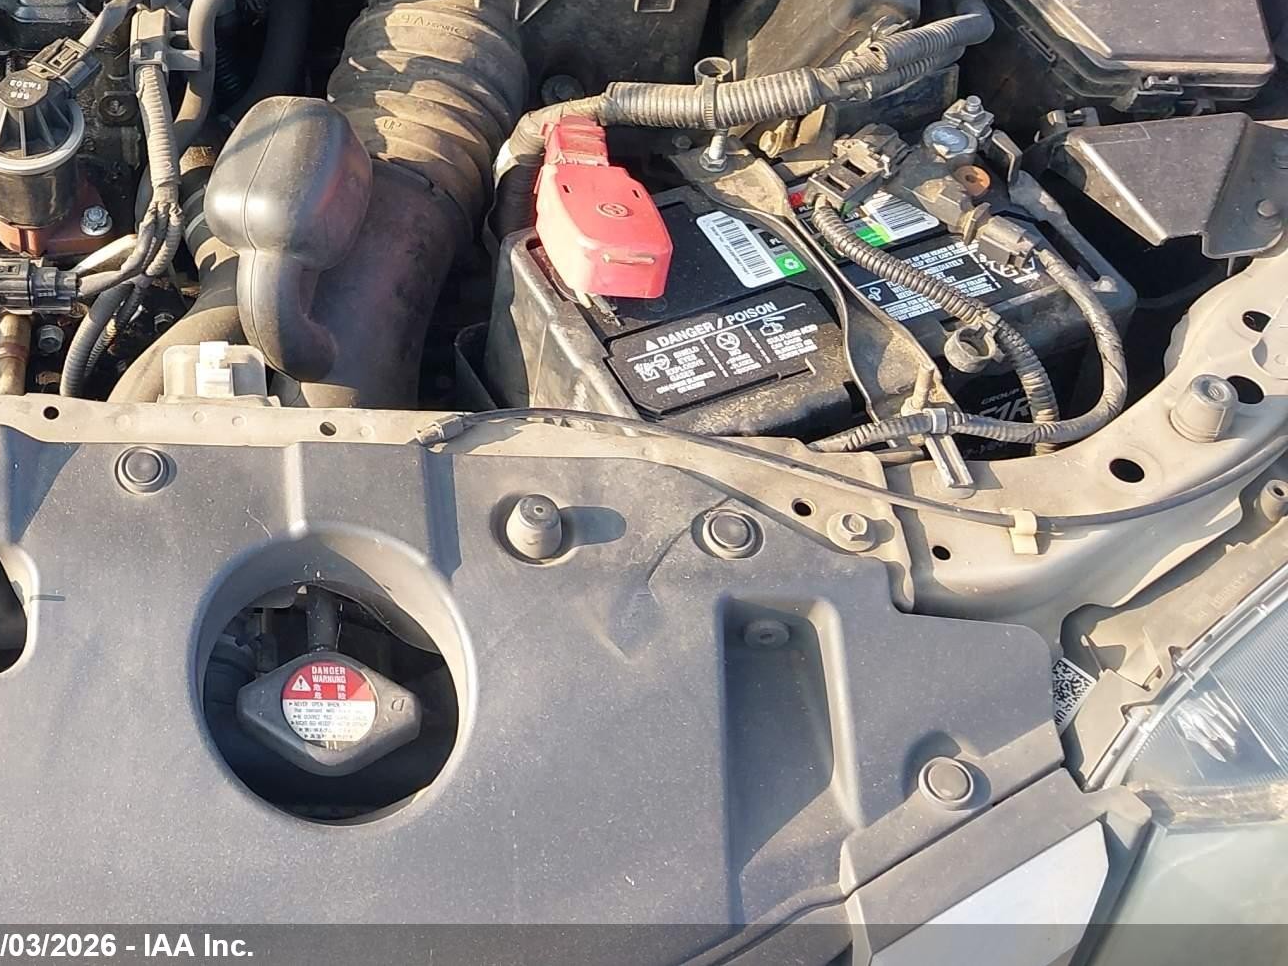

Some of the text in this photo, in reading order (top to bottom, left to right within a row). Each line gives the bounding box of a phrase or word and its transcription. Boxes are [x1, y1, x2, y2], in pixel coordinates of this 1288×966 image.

[656, 301, 778, 347] DANGER / POISON
[312, 665, 346, 675] DANGER
